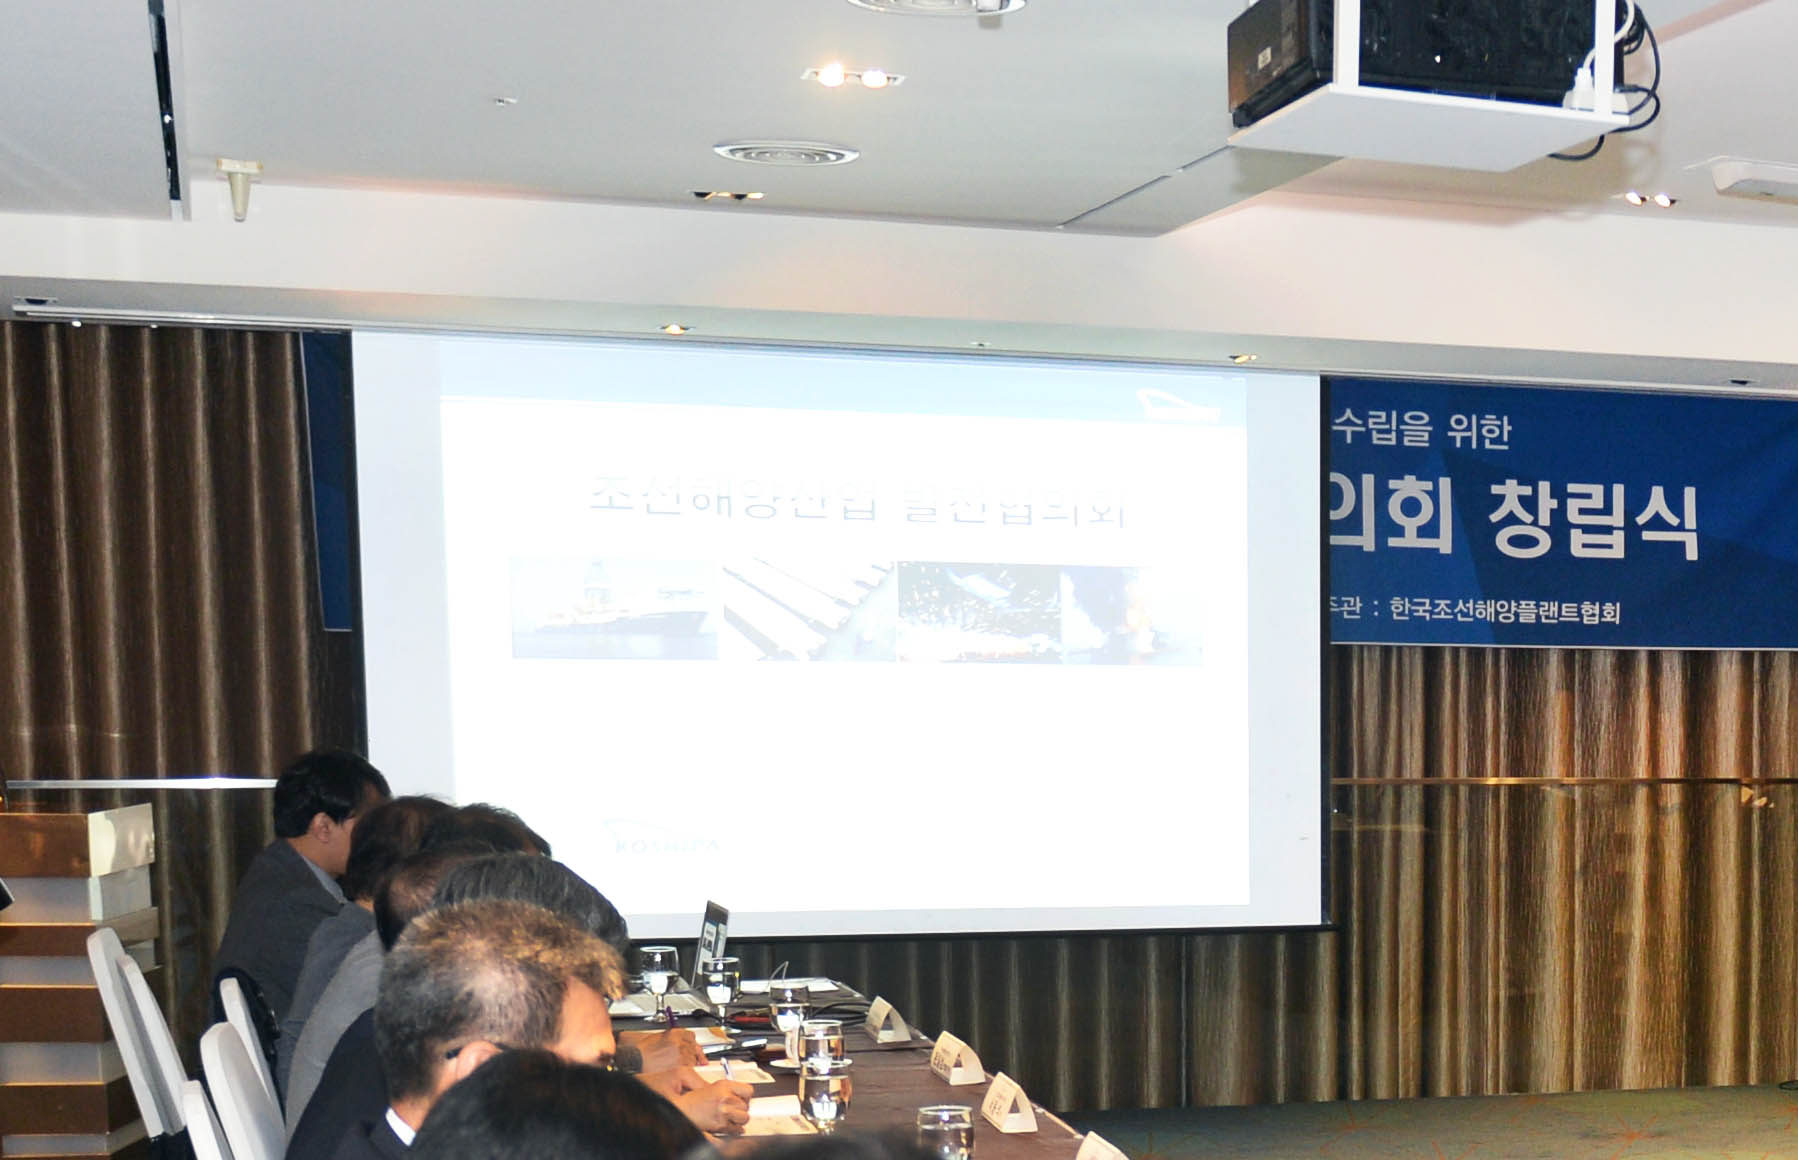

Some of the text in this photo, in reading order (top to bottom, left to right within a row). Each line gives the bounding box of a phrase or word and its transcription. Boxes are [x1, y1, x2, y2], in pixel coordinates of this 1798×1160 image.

[1332, 408, 1513, 450] 수립을 위한
[1488, 479, 1699, 561] 창립식
[1390, 597, 1621, 625] 한국조선해양플랜트협회
